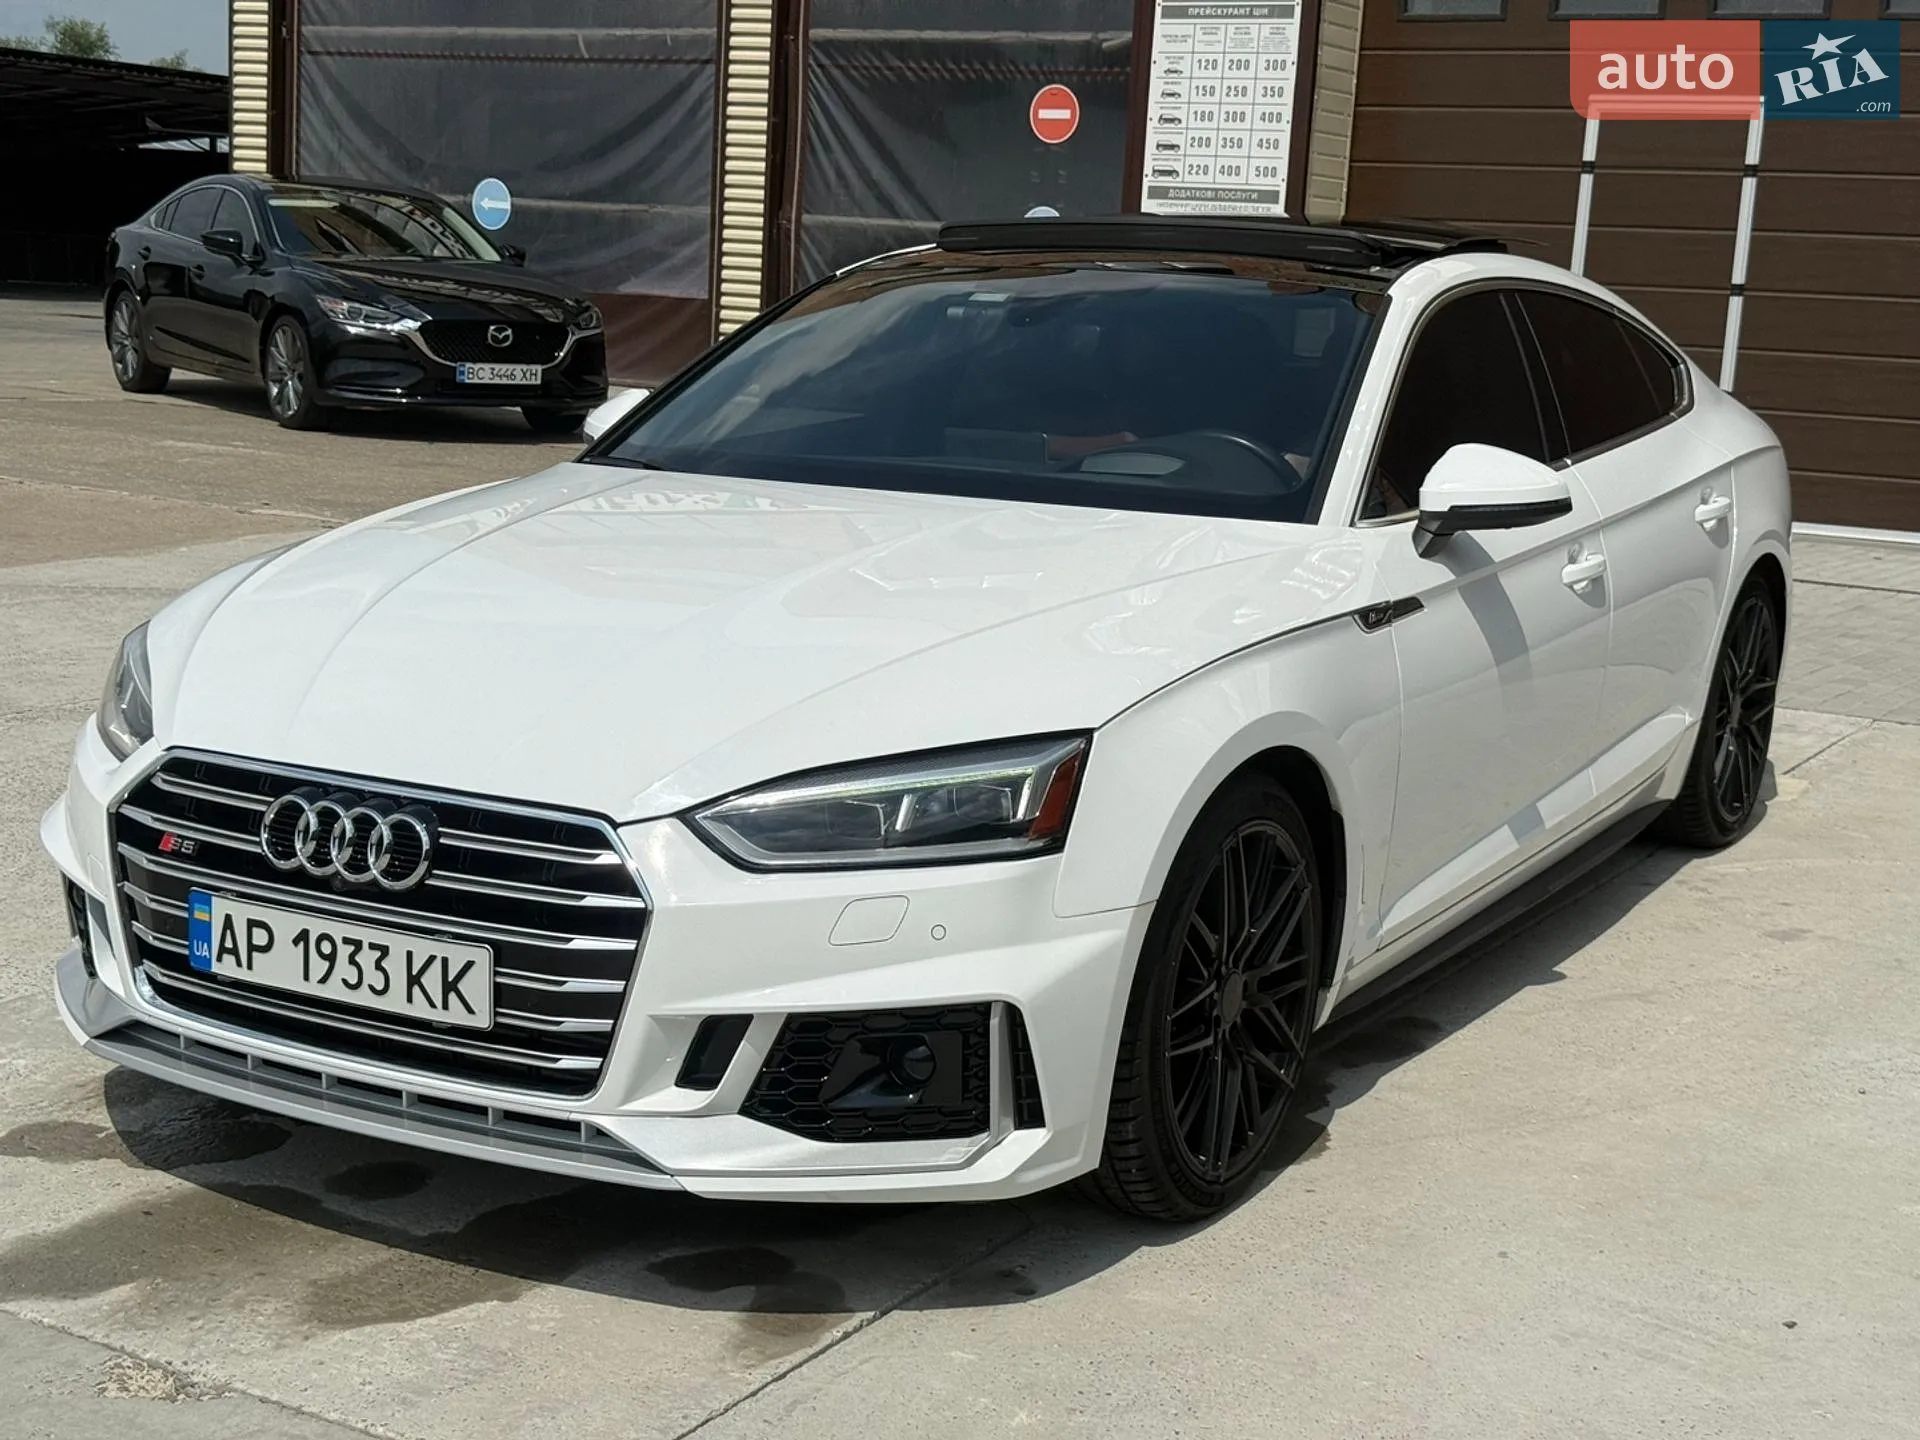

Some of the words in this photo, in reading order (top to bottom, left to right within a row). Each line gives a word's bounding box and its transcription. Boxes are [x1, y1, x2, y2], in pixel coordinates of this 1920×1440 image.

[1188, 6, 1251, 16] ПРЕЙСКУРАНТ
[1197, 58, 1218, 71] 120
[1228, 58, 1250, 71] 200
[1264, 59, 1287, 71] 300
[1195, 85, 1216, 97] 150
[1225, 85, 1248, 97] 250
[1261, 86, 1284, 98] 350
[1193, 110, 1214, 122] 180
[1223, 111, 1246, 123] 300
[1259, 112, 1283, 123] 400
[1189, 136, 1211, 148] 200
[1221, 137, 1243, 149] 350
[1256, 138, 1279, 150] 450
[1188, 164, 1209, 176] 220
[1218, 165, 1241, 176] 400
[1254, 166, 1277, 178] 500
[1168, 188, 1215, 199] ДОДАТКОВІ
[1217, 190, 1258, 200] ПОСЛУГИ
[466, 366, 485, 380] BC
[488, 366, 516, 381] 3446
[520, 368, 538, 381] XH
[193, 937, 210, 960] UA
[215, 912, 275, 971] AP
[291, 927, 390, 997] 1933
[405, 949, 477, 1015] KK
